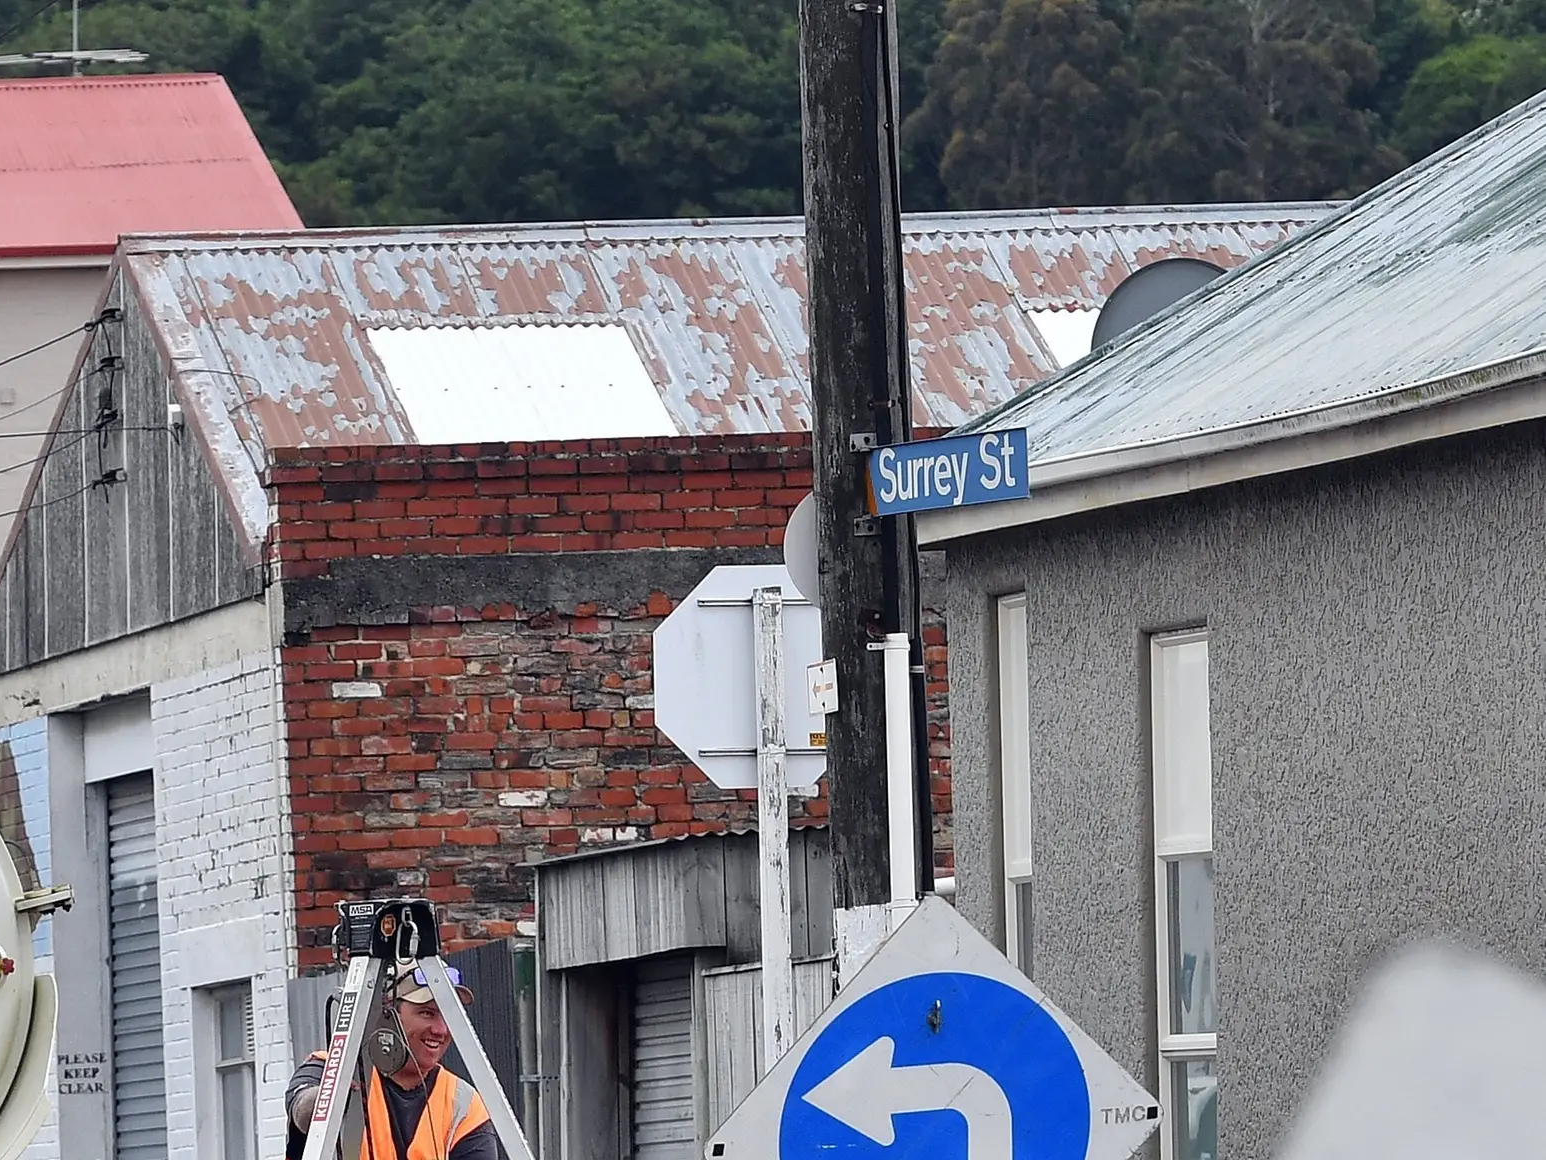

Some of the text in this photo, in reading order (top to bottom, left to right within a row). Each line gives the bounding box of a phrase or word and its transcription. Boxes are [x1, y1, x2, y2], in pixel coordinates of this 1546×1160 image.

[879, 433, 1016, 505] Surrey St
[350, 905, 372, 914] MSA
[57, 1052, 107, 1065] PLEASE
[315, 995, 356, 1118] KENNARDS HIRE
[64, 1067, 99, 1079] KEEP
[59, 1082, 104, 1094] CLEAR
[1100, 1105, 1146, 1124] TMC
